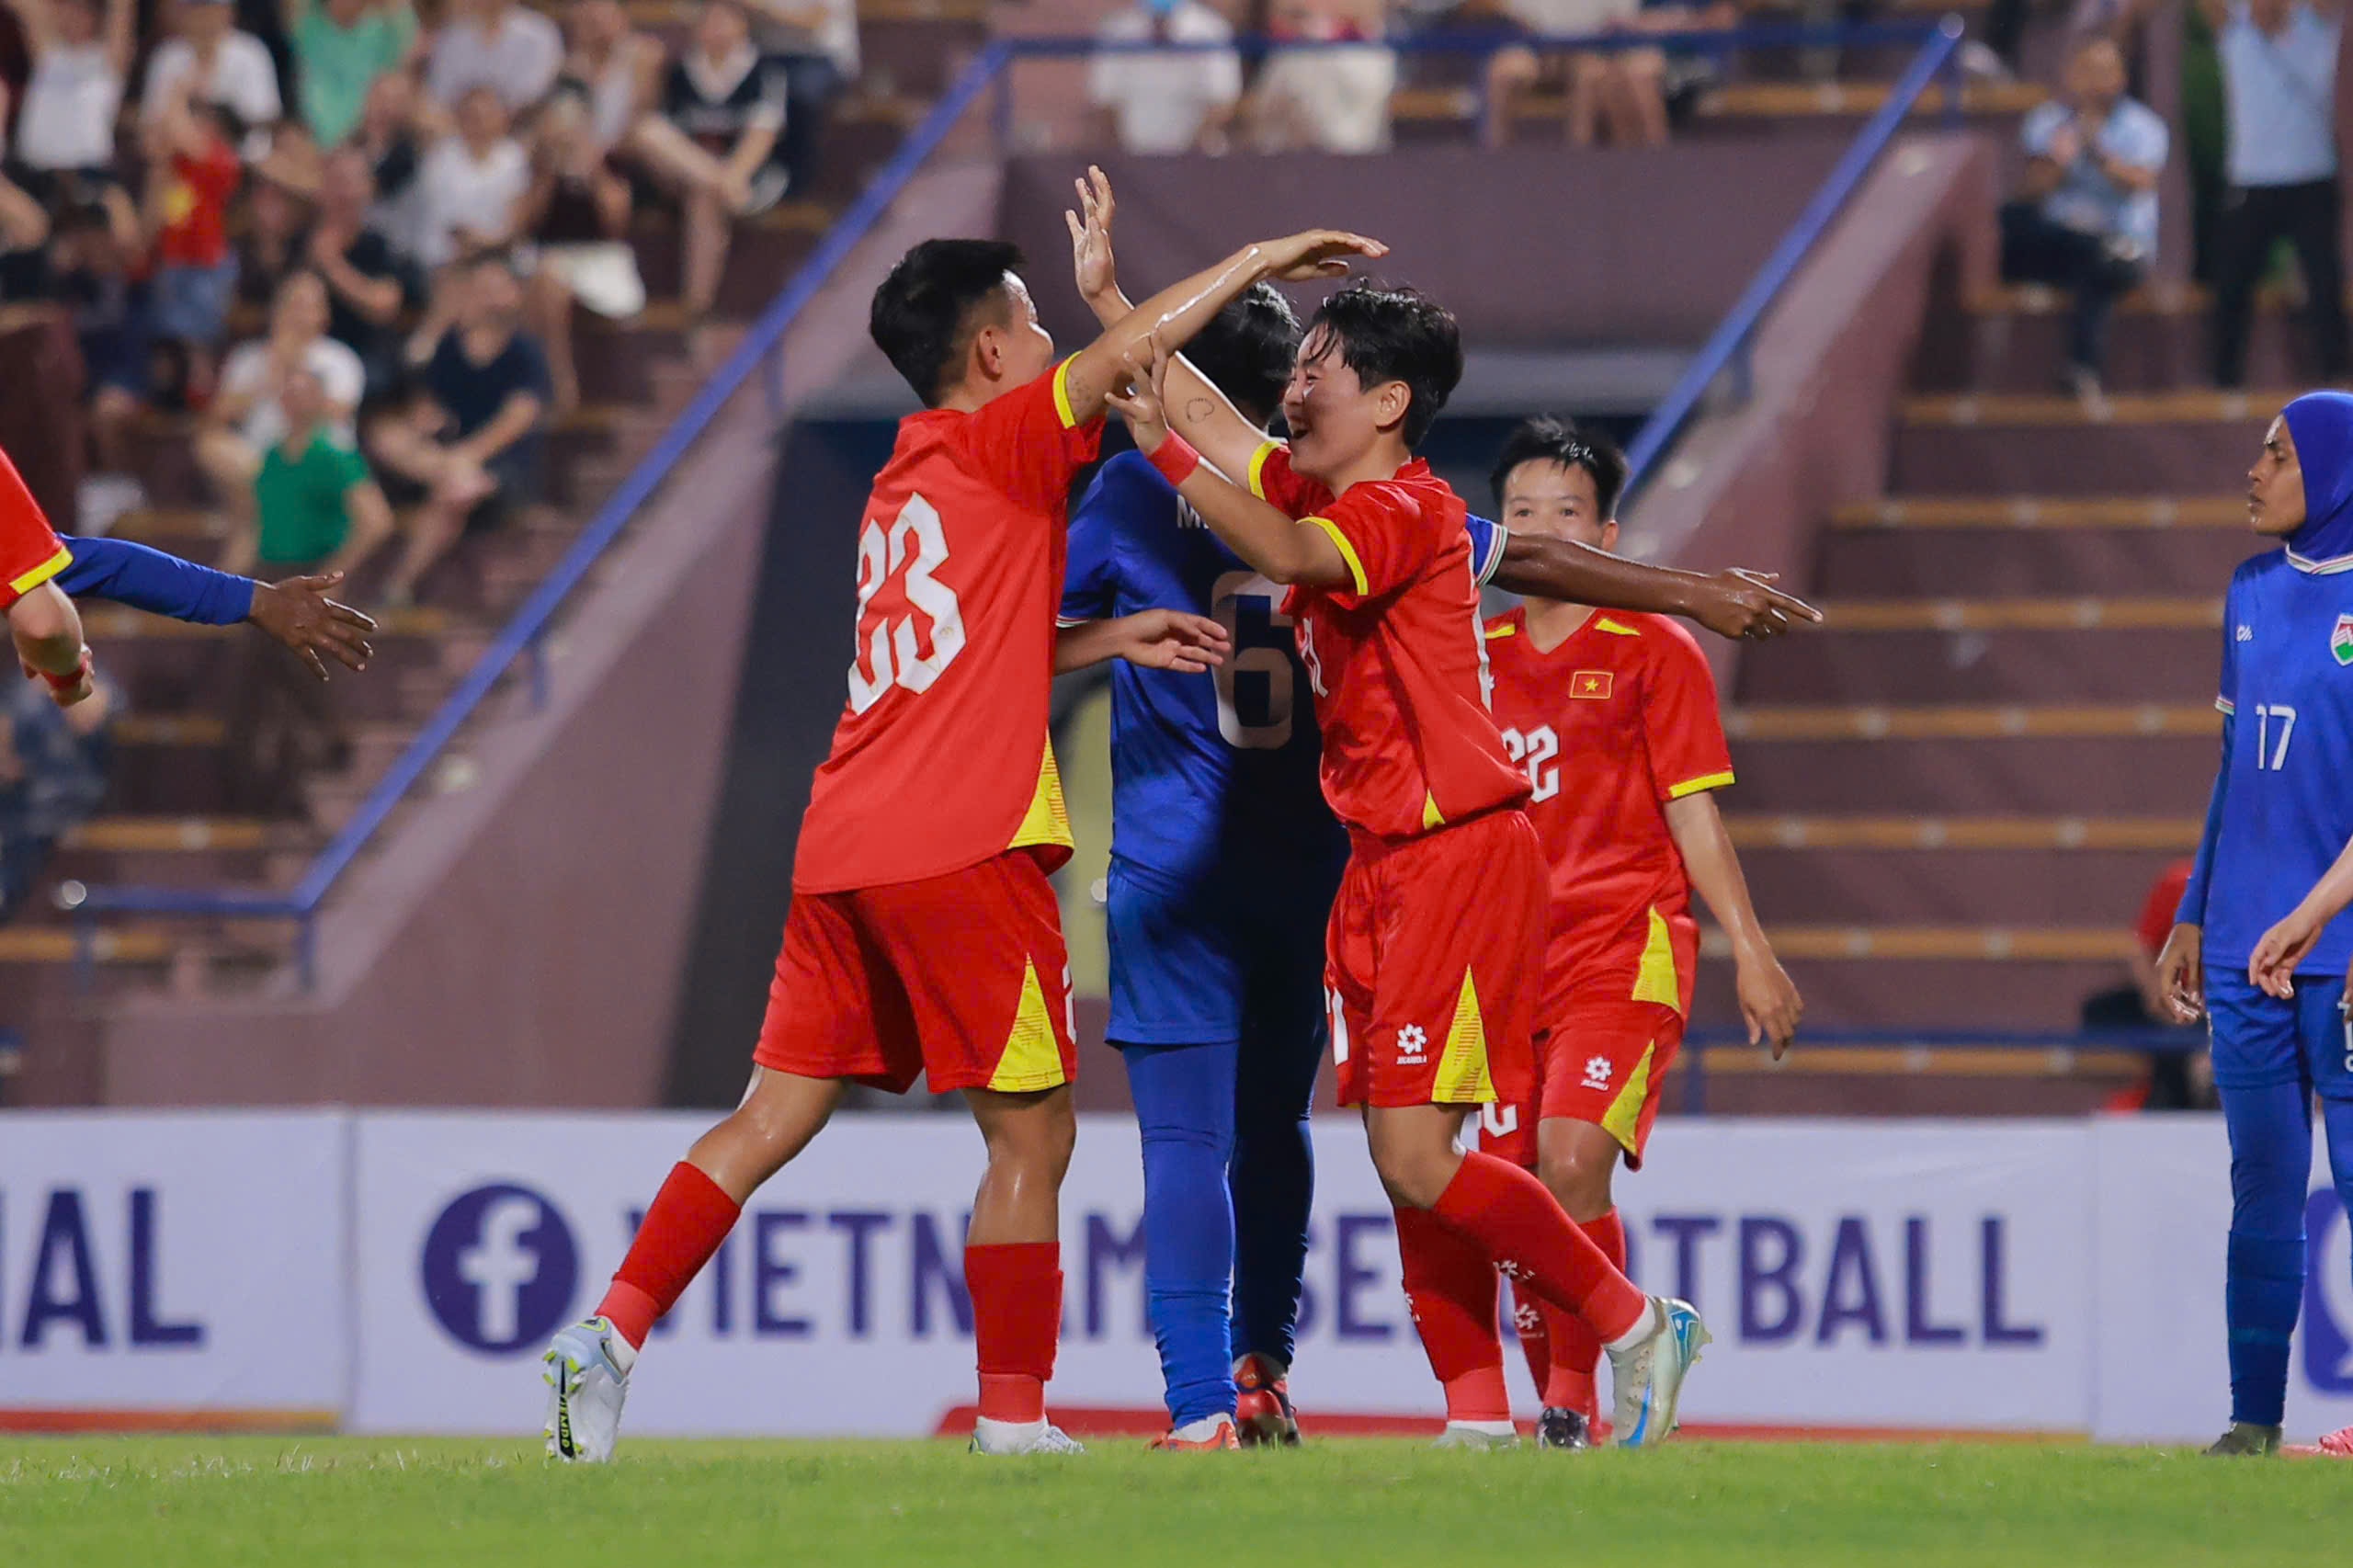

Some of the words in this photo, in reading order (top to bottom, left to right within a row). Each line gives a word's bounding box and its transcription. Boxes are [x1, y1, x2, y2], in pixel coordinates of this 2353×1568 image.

[1211, 571, 1294, 750] 6
[2256, 705, 2296, 770] 17
[0, 1188, 205, 1346] AL
